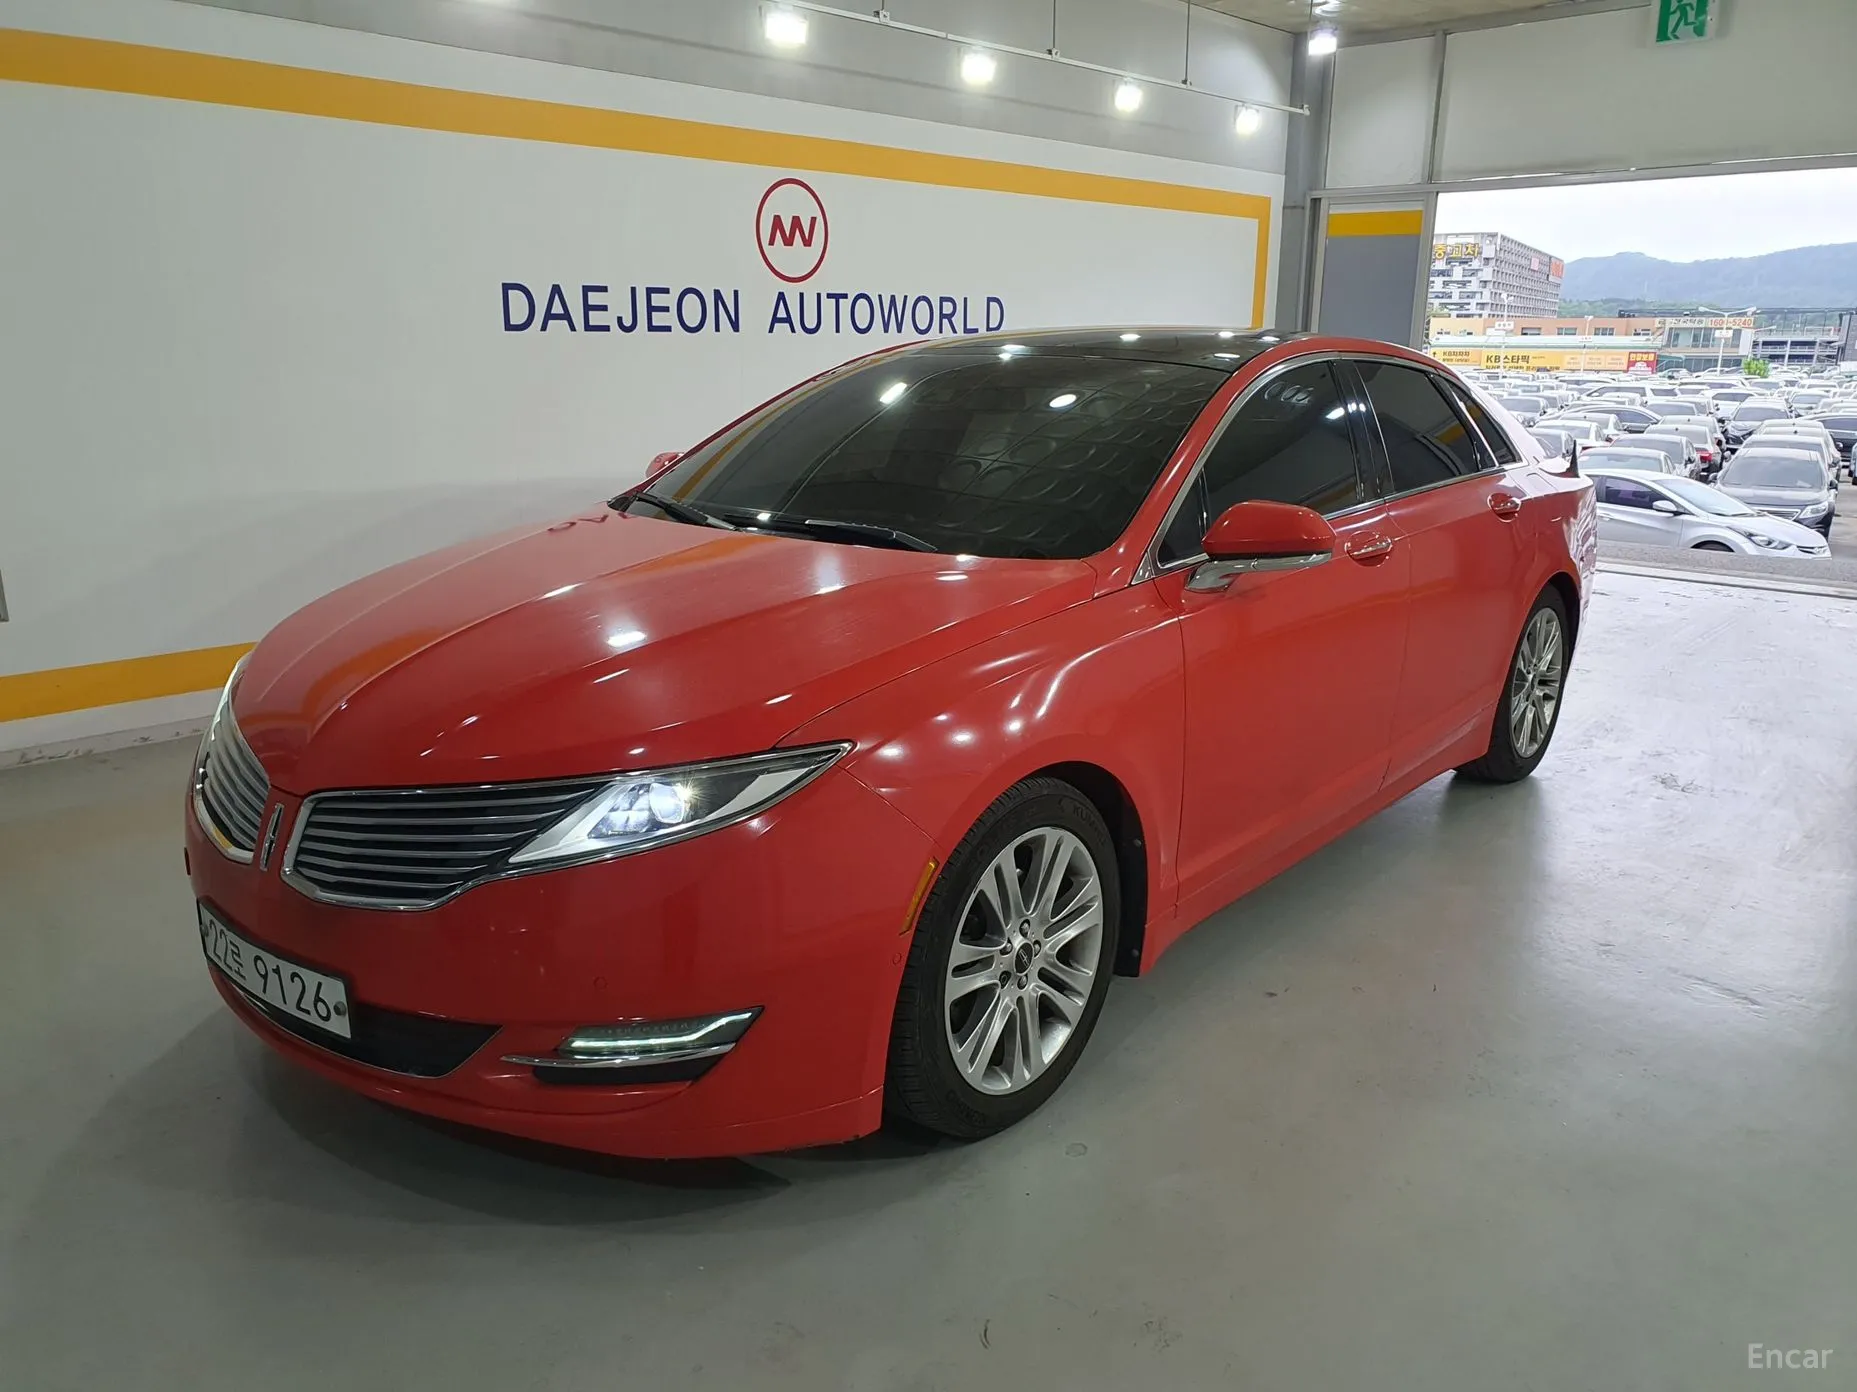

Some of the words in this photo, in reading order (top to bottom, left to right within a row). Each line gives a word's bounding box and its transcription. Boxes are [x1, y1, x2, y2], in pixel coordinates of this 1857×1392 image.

[501, 282, 741, 333] DAEJEON
[767, 290, 1005, 334] AUTOWORLD
[209, 919, 247, 981] 22로
[253, 954, 332, 1022] 9126
